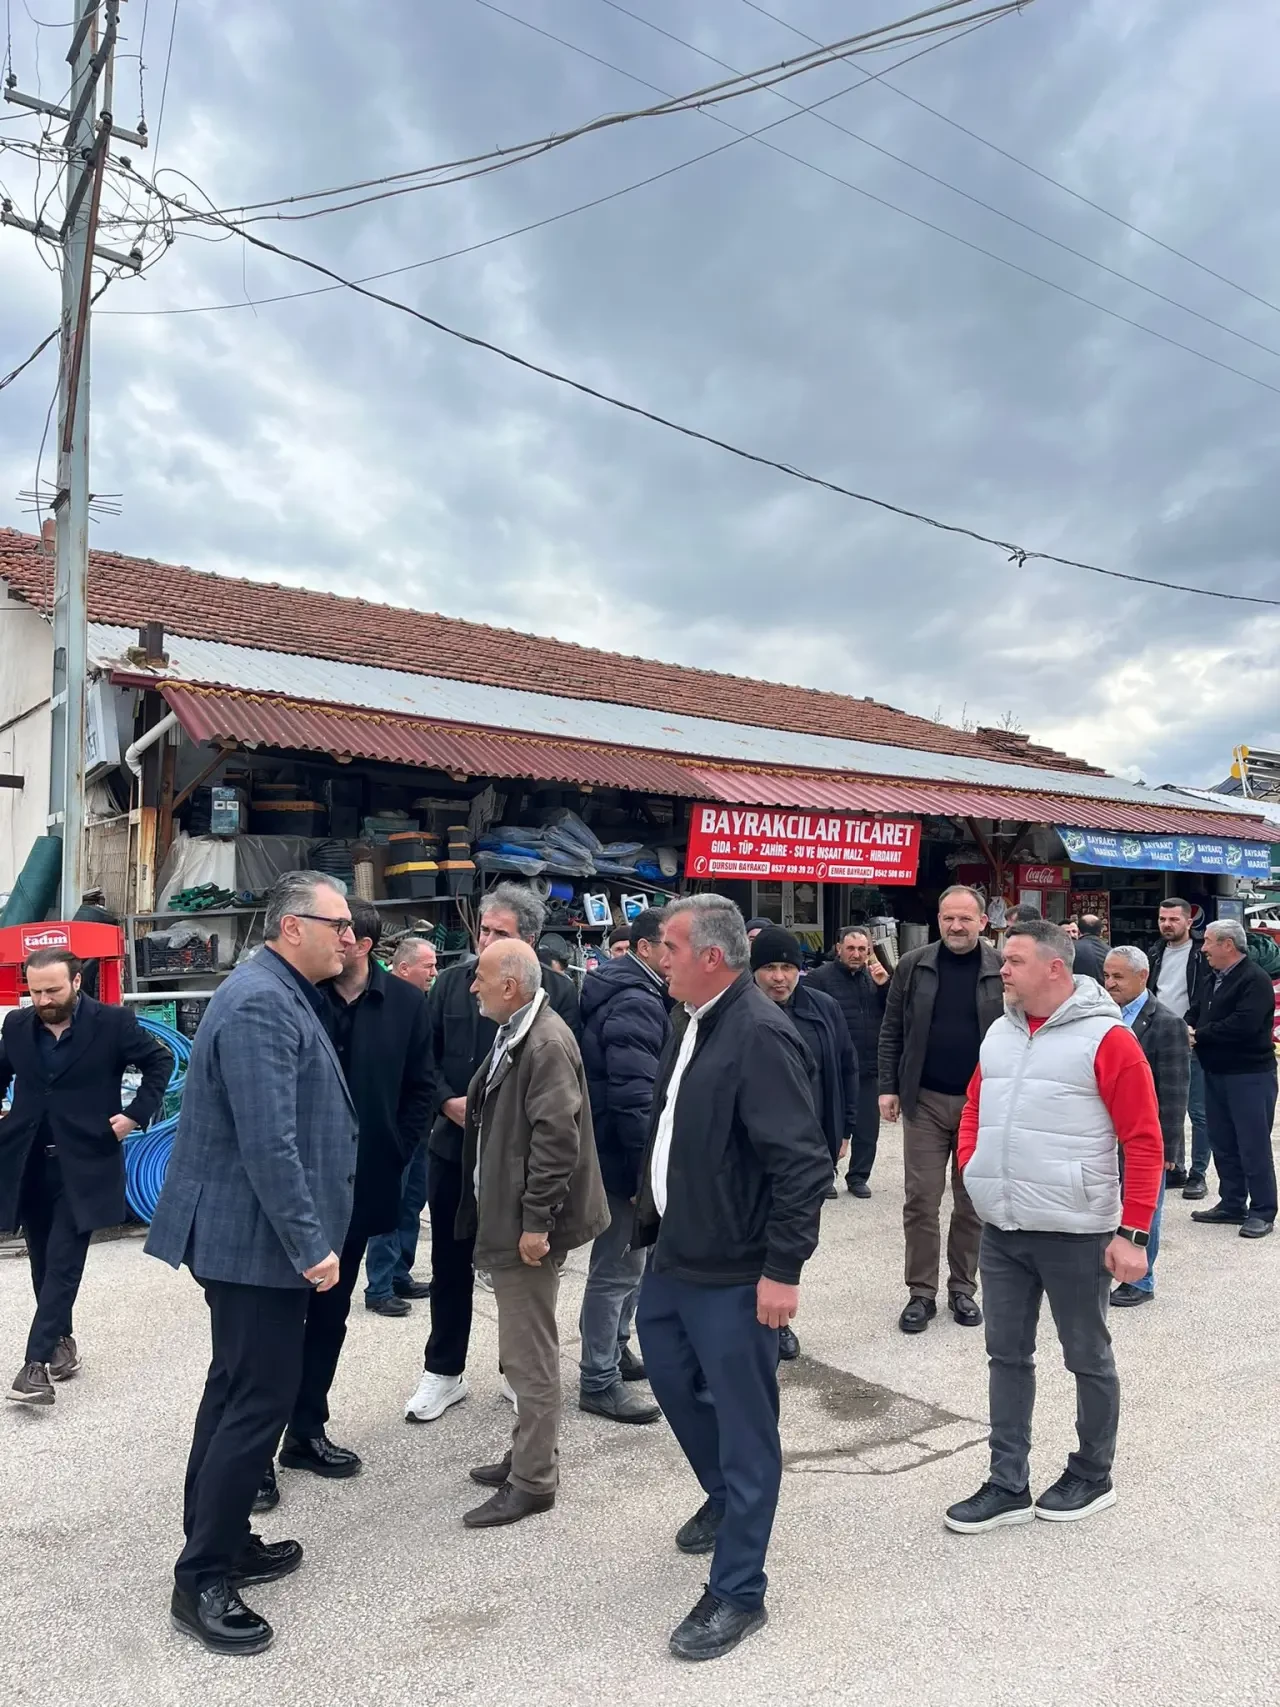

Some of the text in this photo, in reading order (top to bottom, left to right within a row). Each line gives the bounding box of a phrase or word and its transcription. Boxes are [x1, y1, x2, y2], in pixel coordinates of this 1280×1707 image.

[700, 808, 841, 842] BAYRAKCILAR
[711, 840, 731, 854] GIDA
[738, 839, 754, 855] TÜP
[760, 841, 788, 857] ZAHİRE
[793, 845, 805, 858] SU
[805, 845, 816, 859] VE
[711, 861, 738, 871] DURSUN
[738, 862, 768, 872] BAYRAKCI
